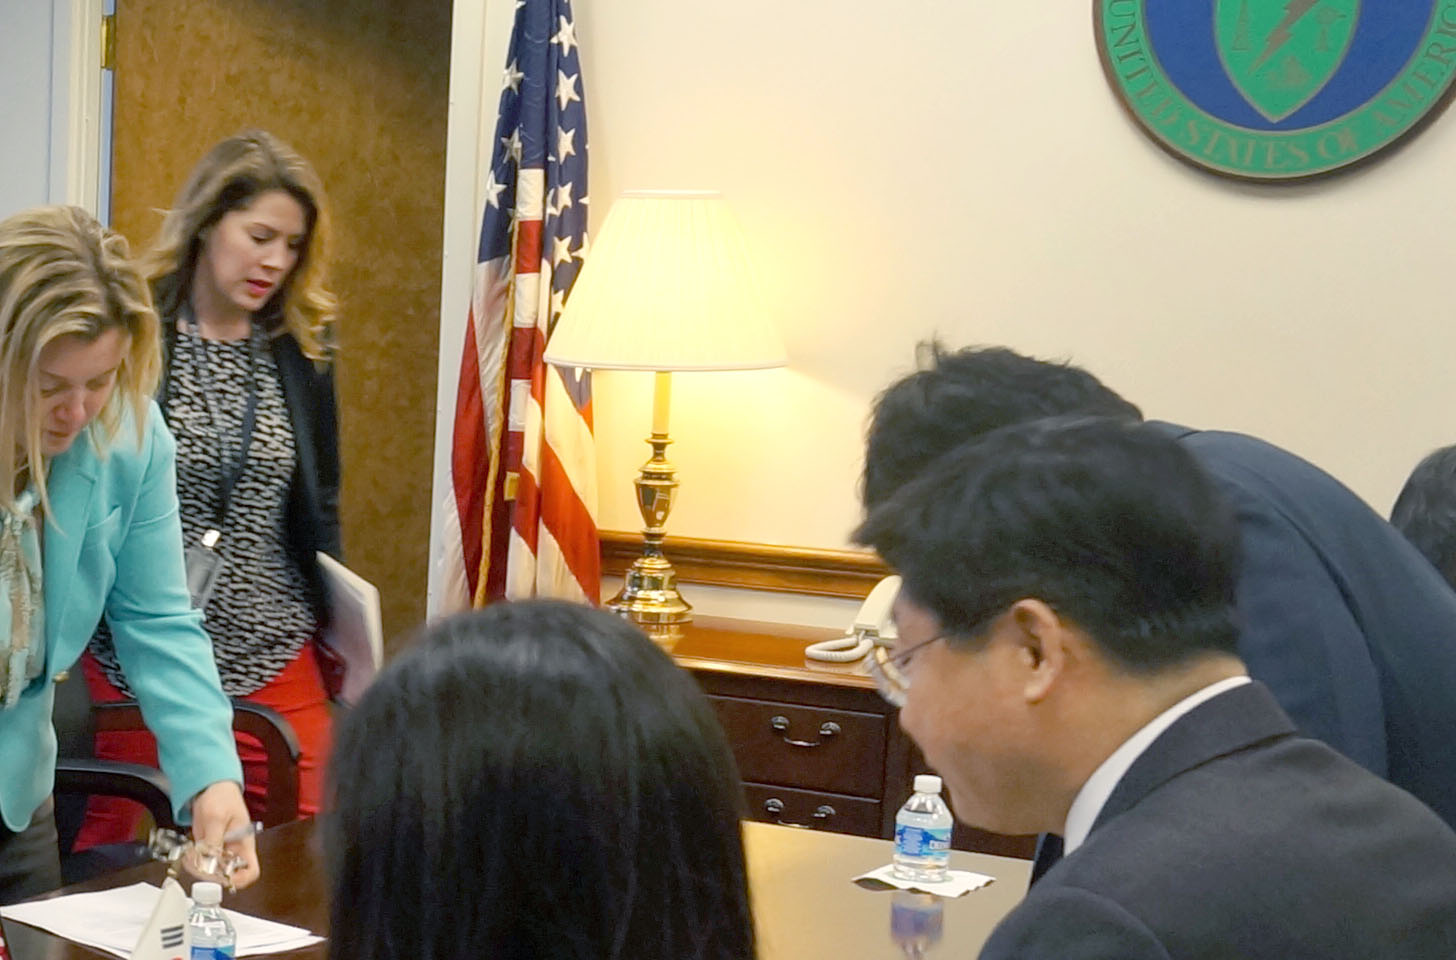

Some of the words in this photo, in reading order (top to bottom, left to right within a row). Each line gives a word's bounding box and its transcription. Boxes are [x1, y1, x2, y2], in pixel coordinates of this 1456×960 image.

[1108, 0, 1181, 126] UNITED
[1185, 120, 1311, 169] STATES
[1316, 126, 1357, 158] OF
[1373, 4, 1456, 137] AMERIC
